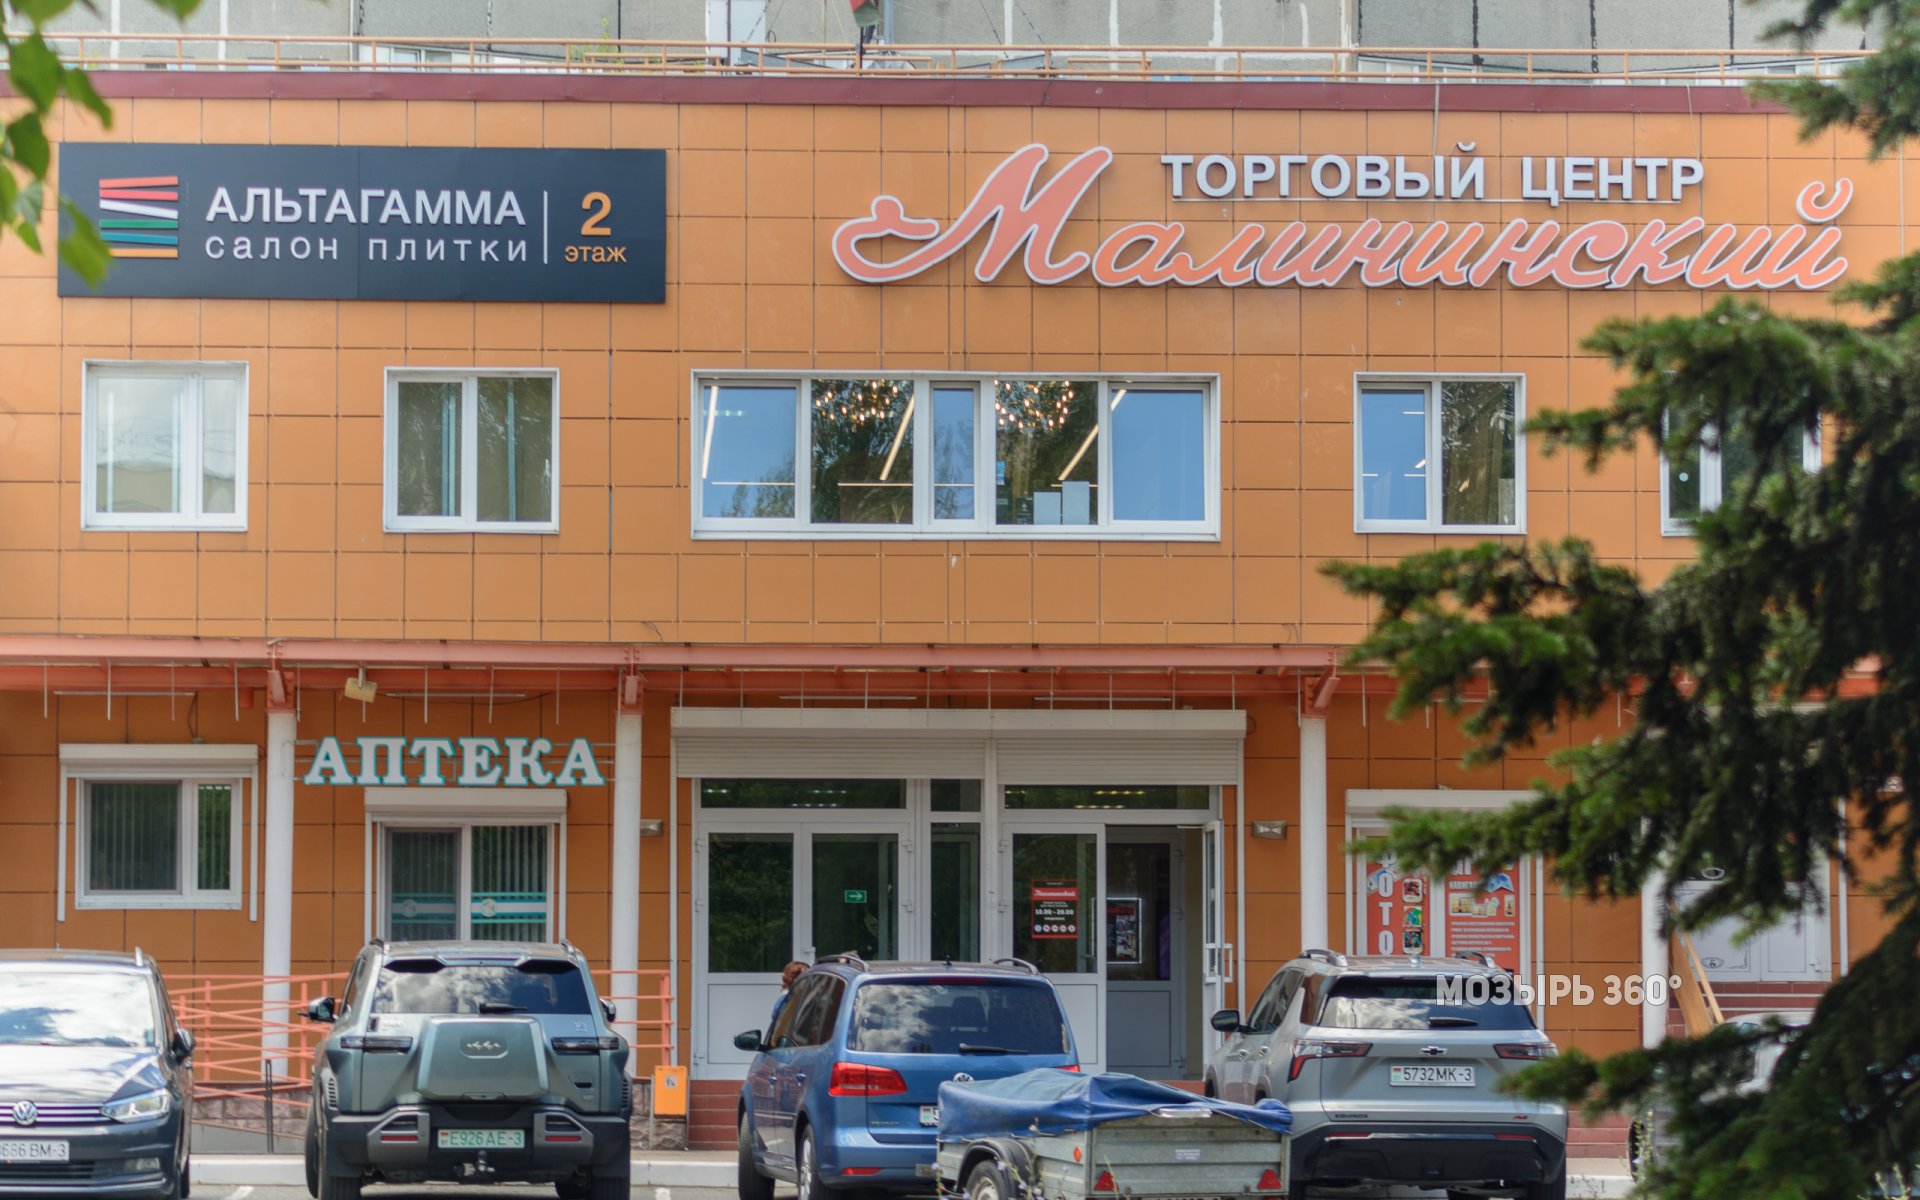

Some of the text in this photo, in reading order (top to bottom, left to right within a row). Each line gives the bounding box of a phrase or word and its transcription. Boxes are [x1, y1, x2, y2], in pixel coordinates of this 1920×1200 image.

[1161, 141, 1704, 207] ТОРГОВЫЙ ЦЕНТР
[205, 186, 526, 226] АЛЬТАГАММА
[580, 191, 612, 236] 2
[832, 143, 1853, 290] Малининский
[205, 235, 528, 263] салон плитки
[564, 242, 627, 265] этаж
[303, 736, 606, 787] АПТЕКА
